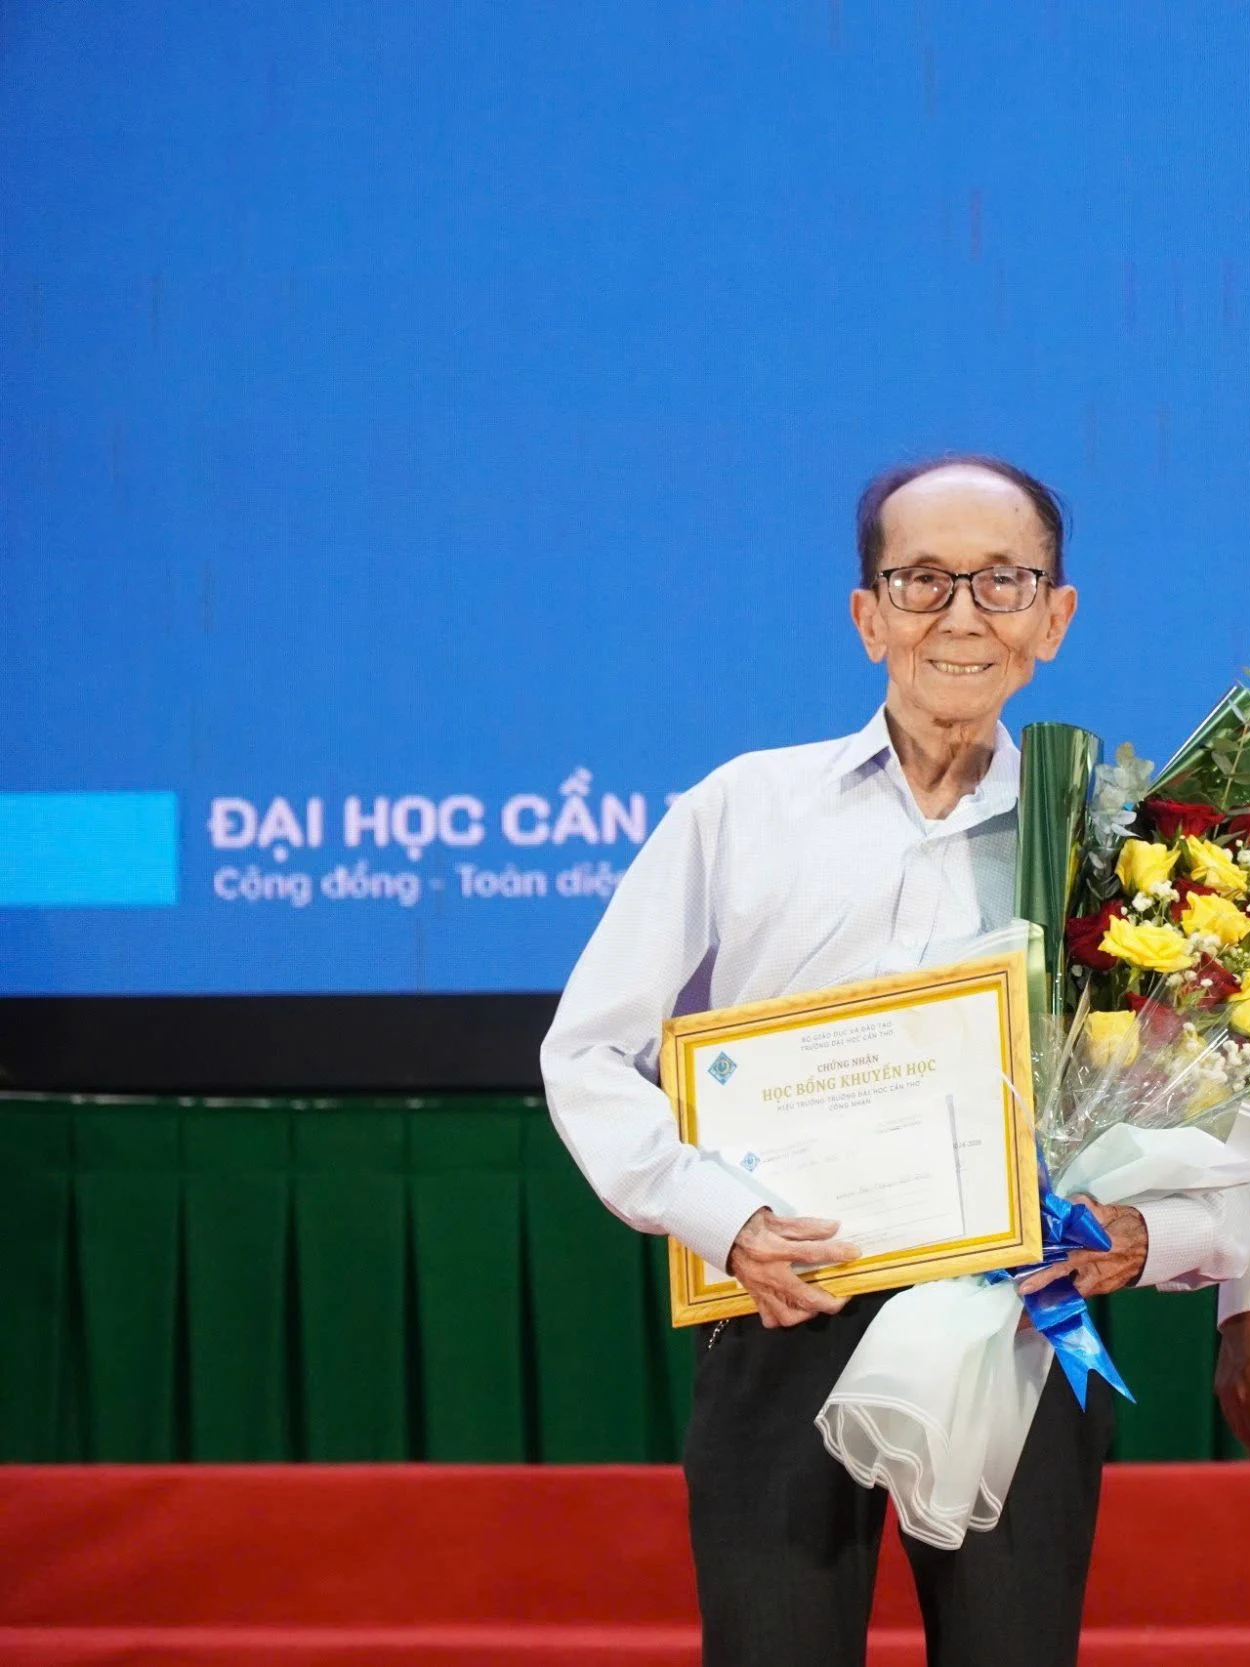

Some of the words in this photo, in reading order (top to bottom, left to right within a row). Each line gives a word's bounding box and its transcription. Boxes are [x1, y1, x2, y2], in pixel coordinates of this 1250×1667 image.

[208, 797, 323, 863] ĐẠI
[344, 795, 484, 862] HỌC
[502, 767, 647, 846] CẦN
[456, 862, 547, 897] Toàn
[763, 1085, 792, 1104] HỌC
[840, 1063, 902, 1088] KHUYẾN
[906, 1059, 936, 1078] HỌC
[817, 1059, 850, 1073] CHỨNG
